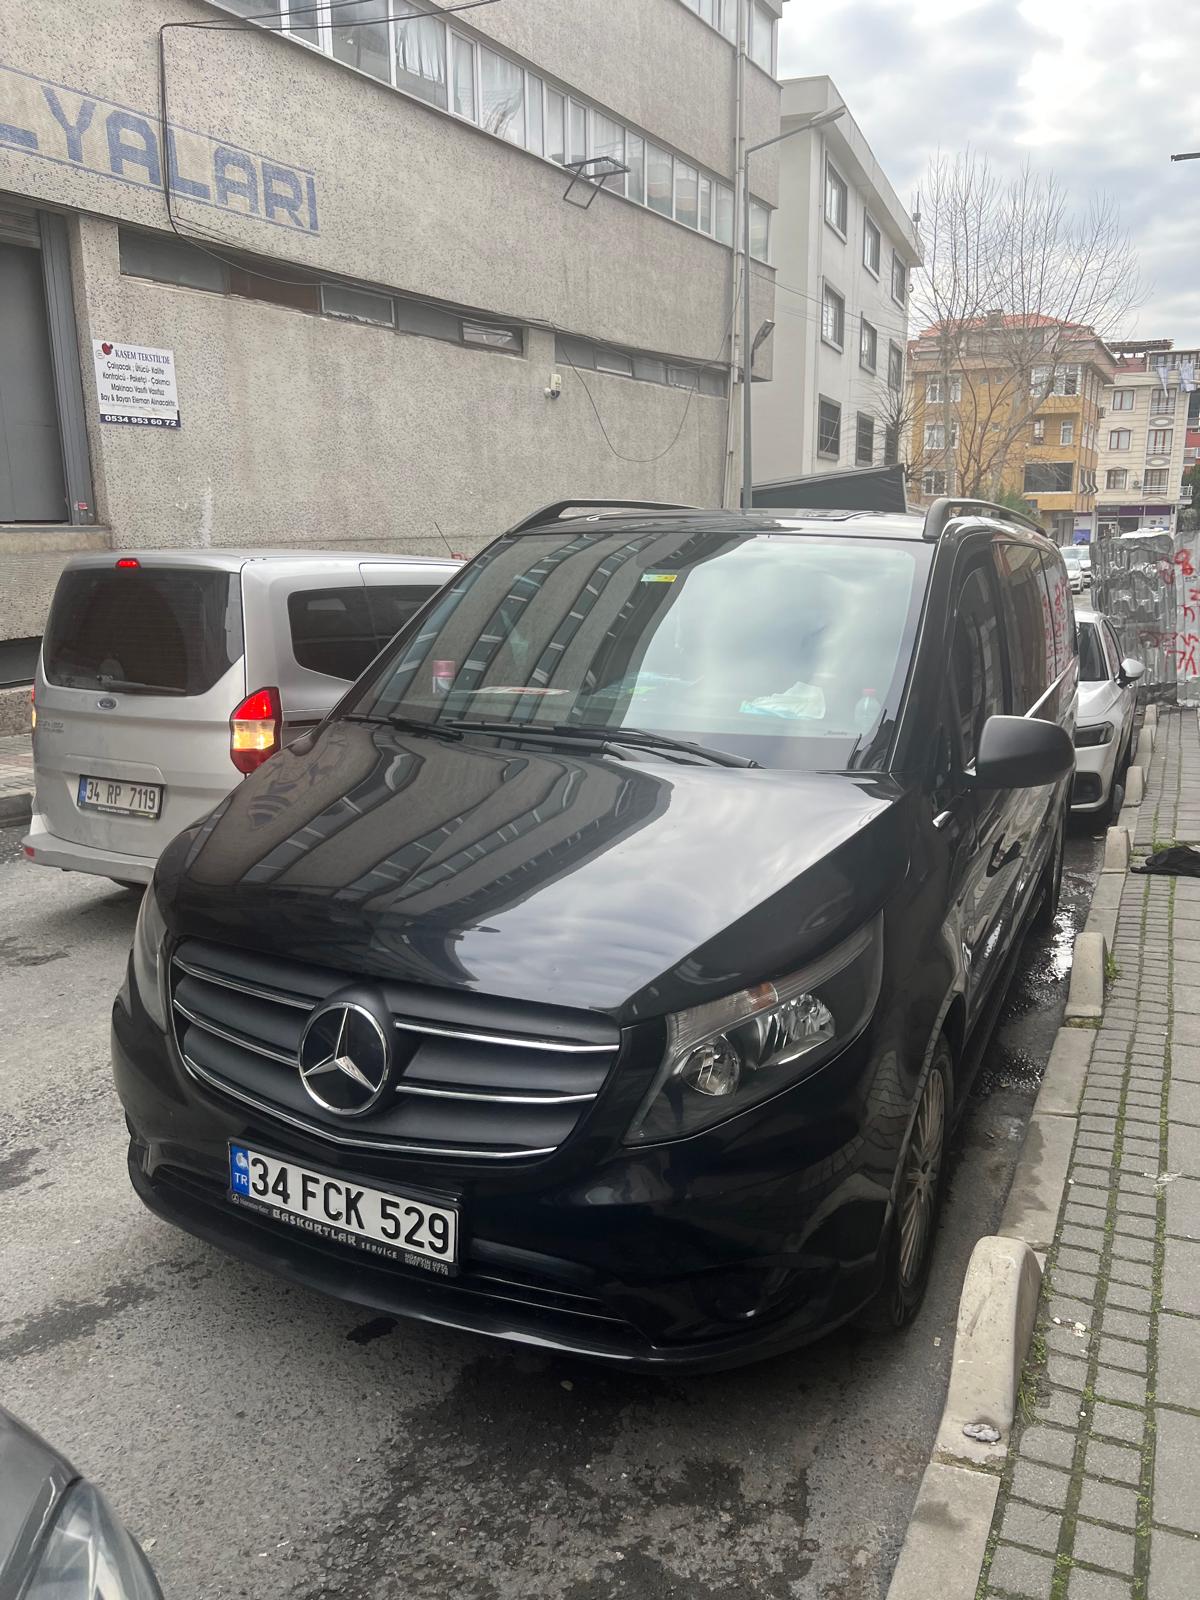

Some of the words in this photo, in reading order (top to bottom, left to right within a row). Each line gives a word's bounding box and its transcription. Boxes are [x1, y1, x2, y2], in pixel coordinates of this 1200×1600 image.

[151, 366, 164, 375] Kalite
[102, 372, 125, 381] Kontrolcü
[101, 393, 110, 402] Bay
[116, 395, 131, 403] Bayan
[132, 396, 150, 404] Eleman
[105, 415, 129, 423] 0534
[87, 781, 100, 801] 34
[107, 784, 121, 804] RP
[129, 787, 156, 810] 7119
[234, 1172, 248, 1186] TR
[251, 1157, 291, 1205] 34
[301, 1173, 365, 1230] FCK
[380, 1198, 449, 1255] 529
